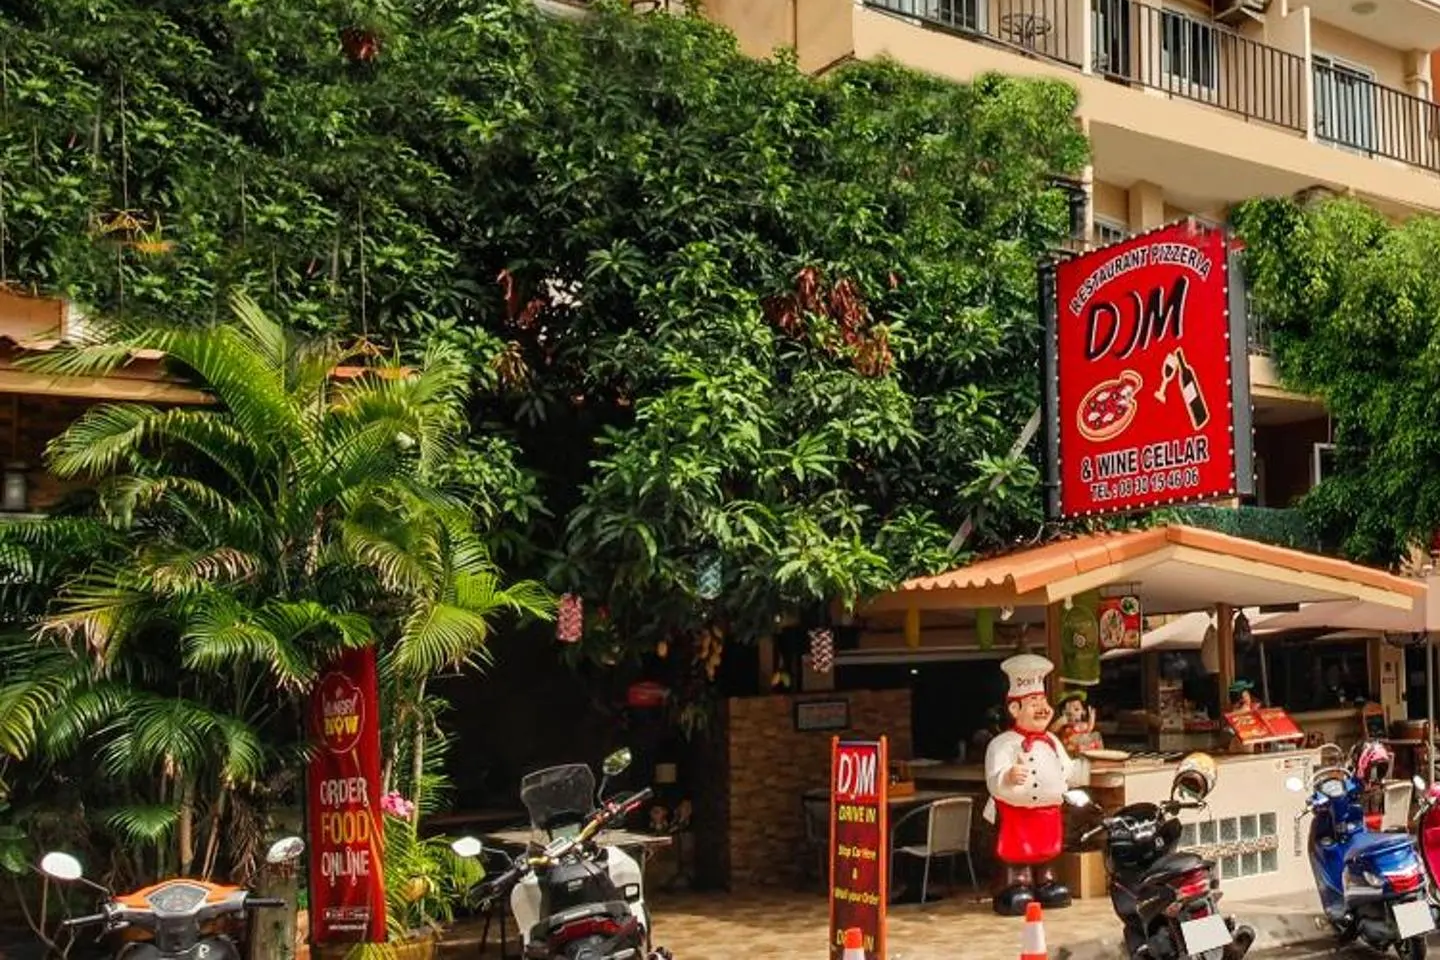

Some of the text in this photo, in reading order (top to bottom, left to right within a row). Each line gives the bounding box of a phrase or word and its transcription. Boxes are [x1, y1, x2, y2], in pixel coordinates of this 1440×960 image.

[1069, 242, 1212, 317] RESTAURANT PIZZERIA
[1081, 435, 1210, 482] & WINE CELLAR
[320, 776, 368, 808] ORDER
[320, 809, 370, 844] FOOD
[838, 804, 877, 823] DRIVE IN
[321, 847, 369, 887] ONLINE
